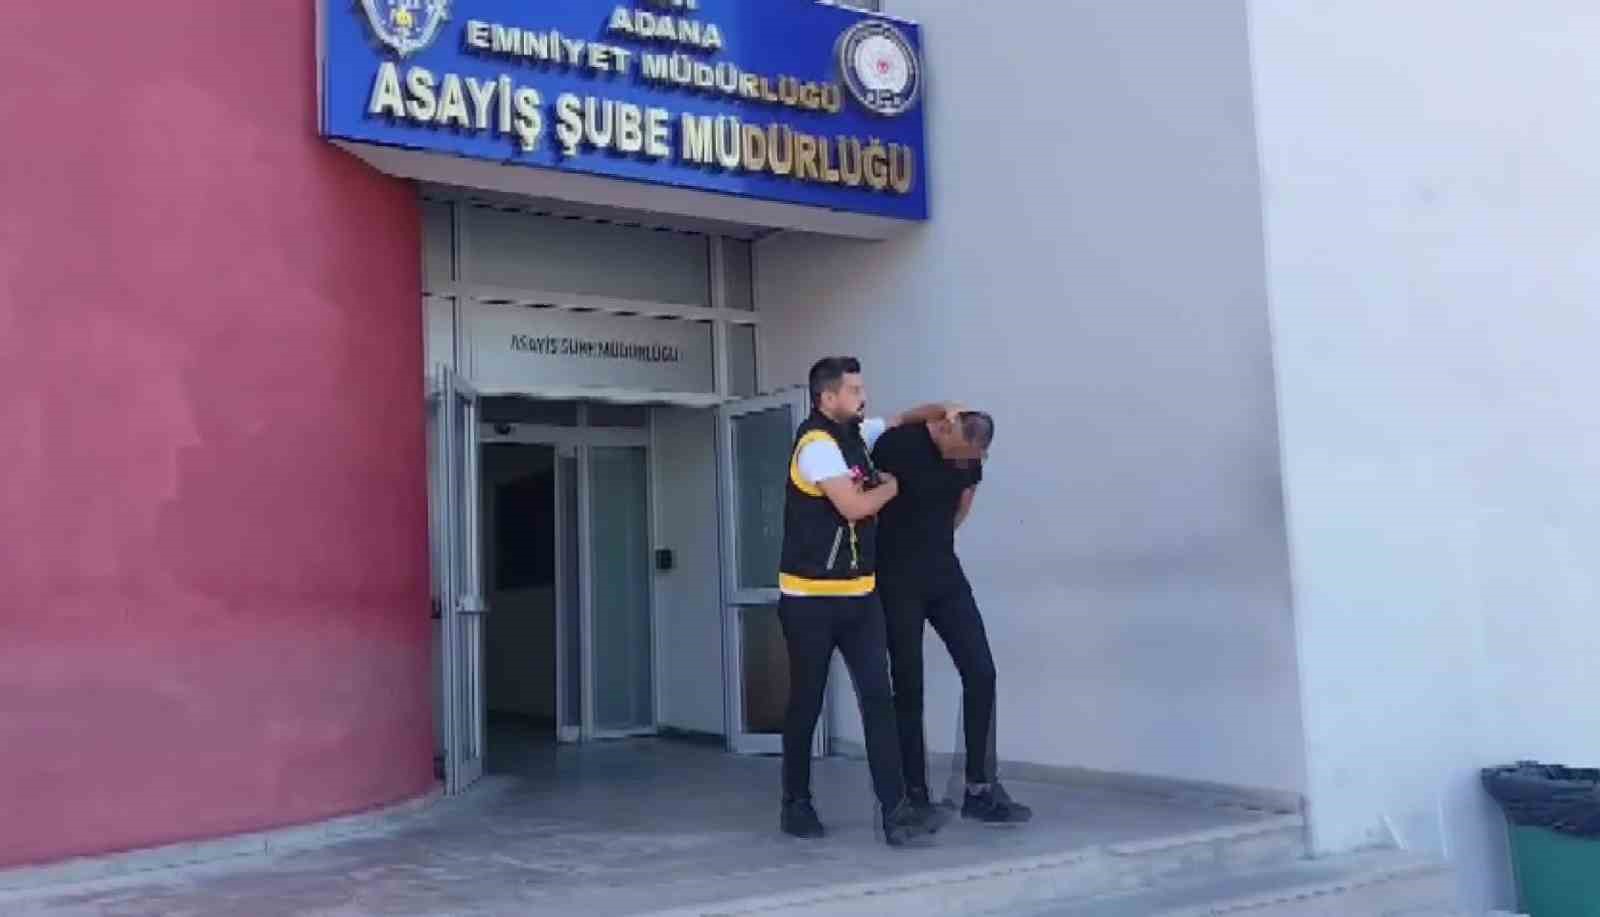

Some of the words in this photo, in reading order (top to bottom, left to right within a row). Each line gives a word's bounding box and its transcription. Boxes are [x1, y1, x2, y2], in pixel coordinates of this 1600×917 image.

[466, 20, 630, 73] EMNİYET
[608, 7, 723, 49] ADANA
[368, 62, 542, 152] ASAYİŞ
[556, 92, 670, 156] ŞUBE
[682, 110, 913, 193] MÜDÜRLÜĞÜ
